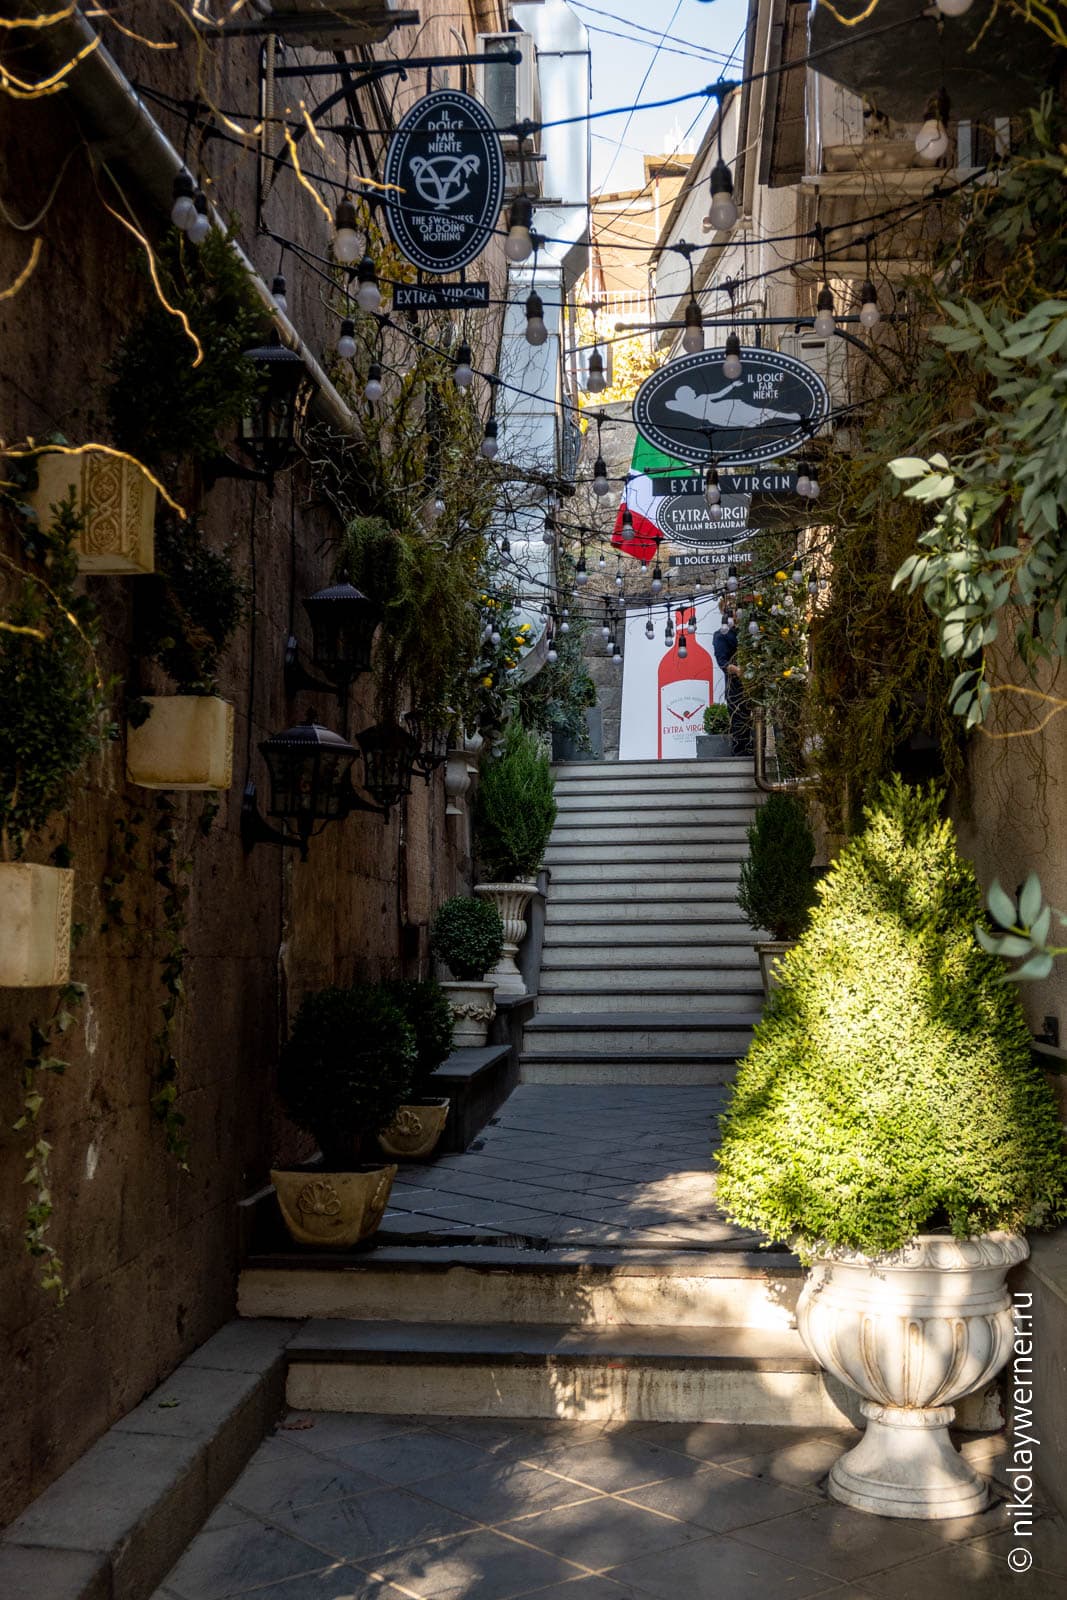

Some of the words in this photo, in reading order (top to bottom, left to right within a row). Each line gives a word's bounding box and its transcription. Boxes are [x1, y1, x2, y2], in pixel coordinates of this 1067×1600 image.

[441, 110, 450, 121] IL
[436, 132, 455, 142] FAR
[428, 142, 463, 153] NIENTE
[411, 216, 426, 225] THE
[419, 224, 432, 233] OF
[435, 224, 465, 233] DOING
[423, 232, 461, 241] NOTHING
[397, 288, 437, 304] EXTRA
[747, 373, 755, 383] IL
[757, 372, 784, 382] DOLCE
[758, 382, 774, 391] FAR
[753, 390, 779, 400] NIENTE
[670, 479, 721, 493] EXTR
[733, 476, 790, 490] VIRGIN
[672, 508, 710, 523] EXTRA
[720, 506, 748, 520] IRGI
[675, 523, 703, 531] ITALIAN
[704, 520, 746, 530] RESTAURAN
[675, 557, 682, 565] IL
[684, 555, 710, 564] DOLCE
[711, 554, 726, 563] FAR
[727, 553, 752, 563] NIENTE
[663, 726, 684, 735] EXTRA
[686, 724, 706, 733] VIRGI
